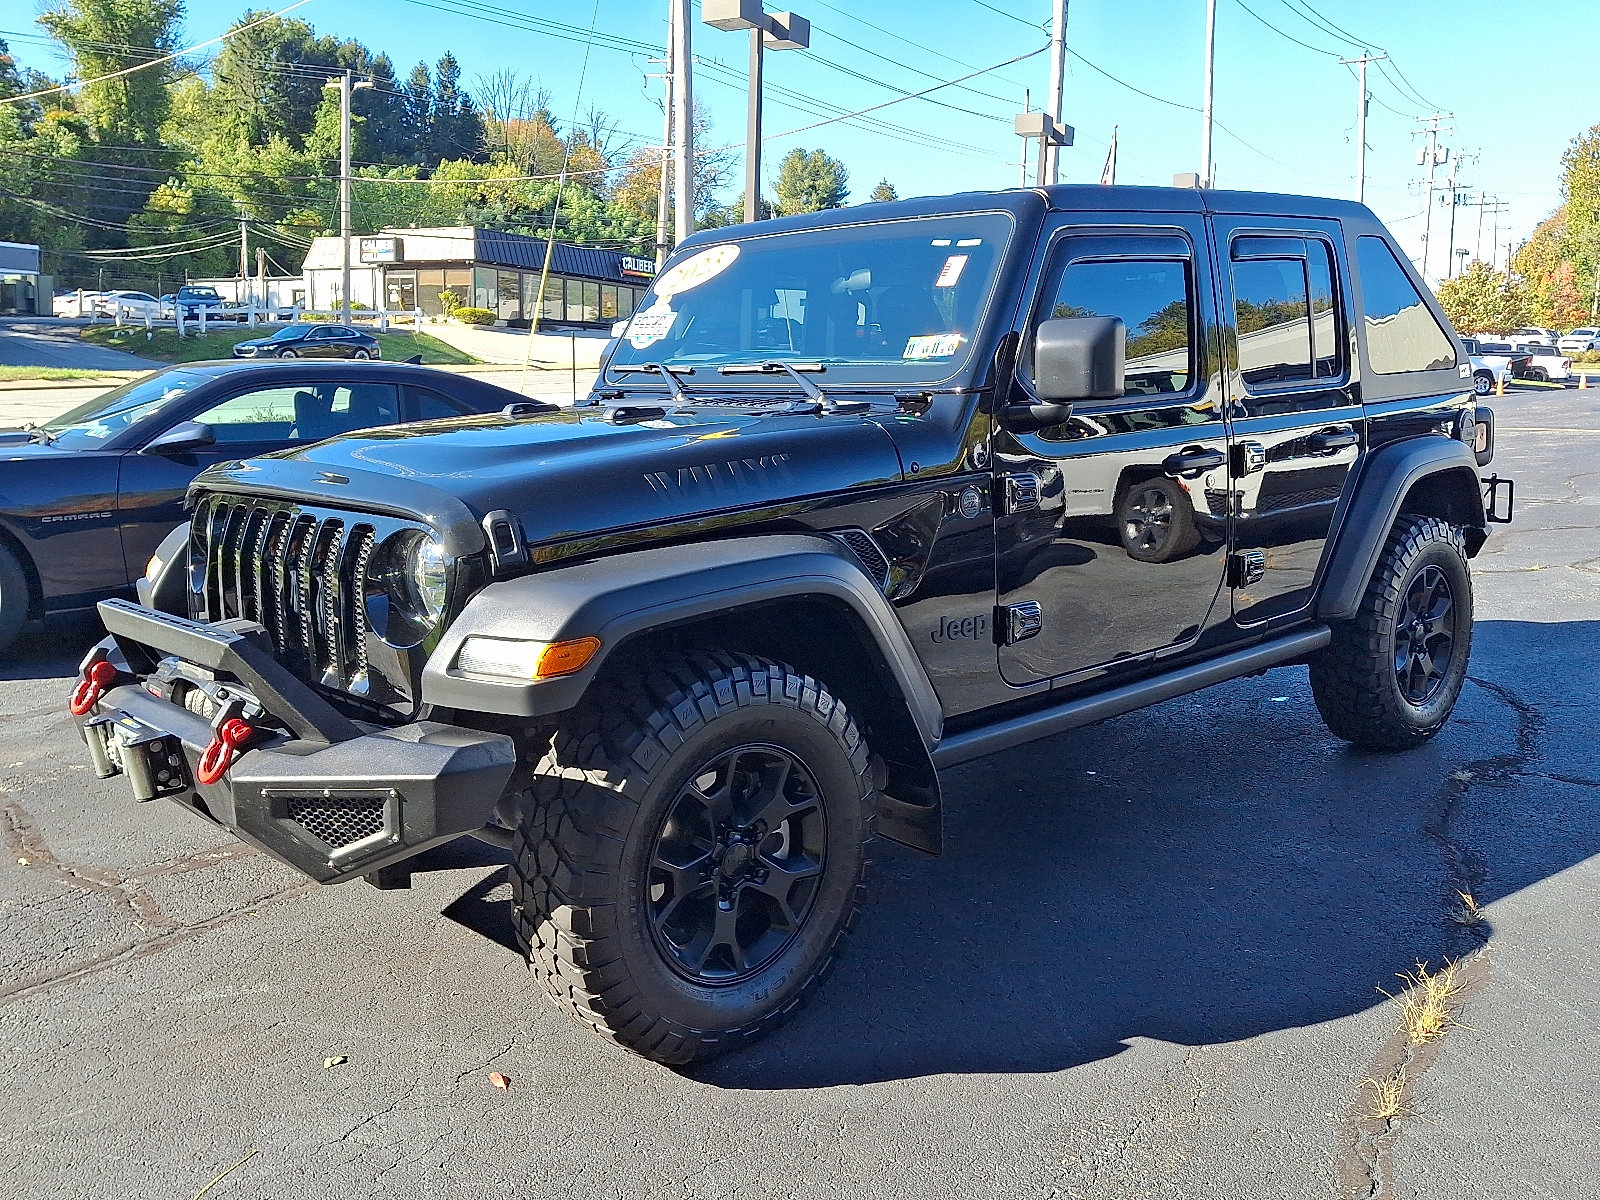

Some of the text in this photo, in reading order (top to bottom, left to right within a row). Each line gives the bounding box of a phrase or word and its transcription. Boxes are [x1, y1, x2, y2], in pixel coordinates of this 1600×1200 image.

[622, 256, 654, 274] CALIBER
[643, 452, 793, 499] WILLYS
[41, 511, 112, 523] CAMARO
[930, 614, 986, 644] Jeep
